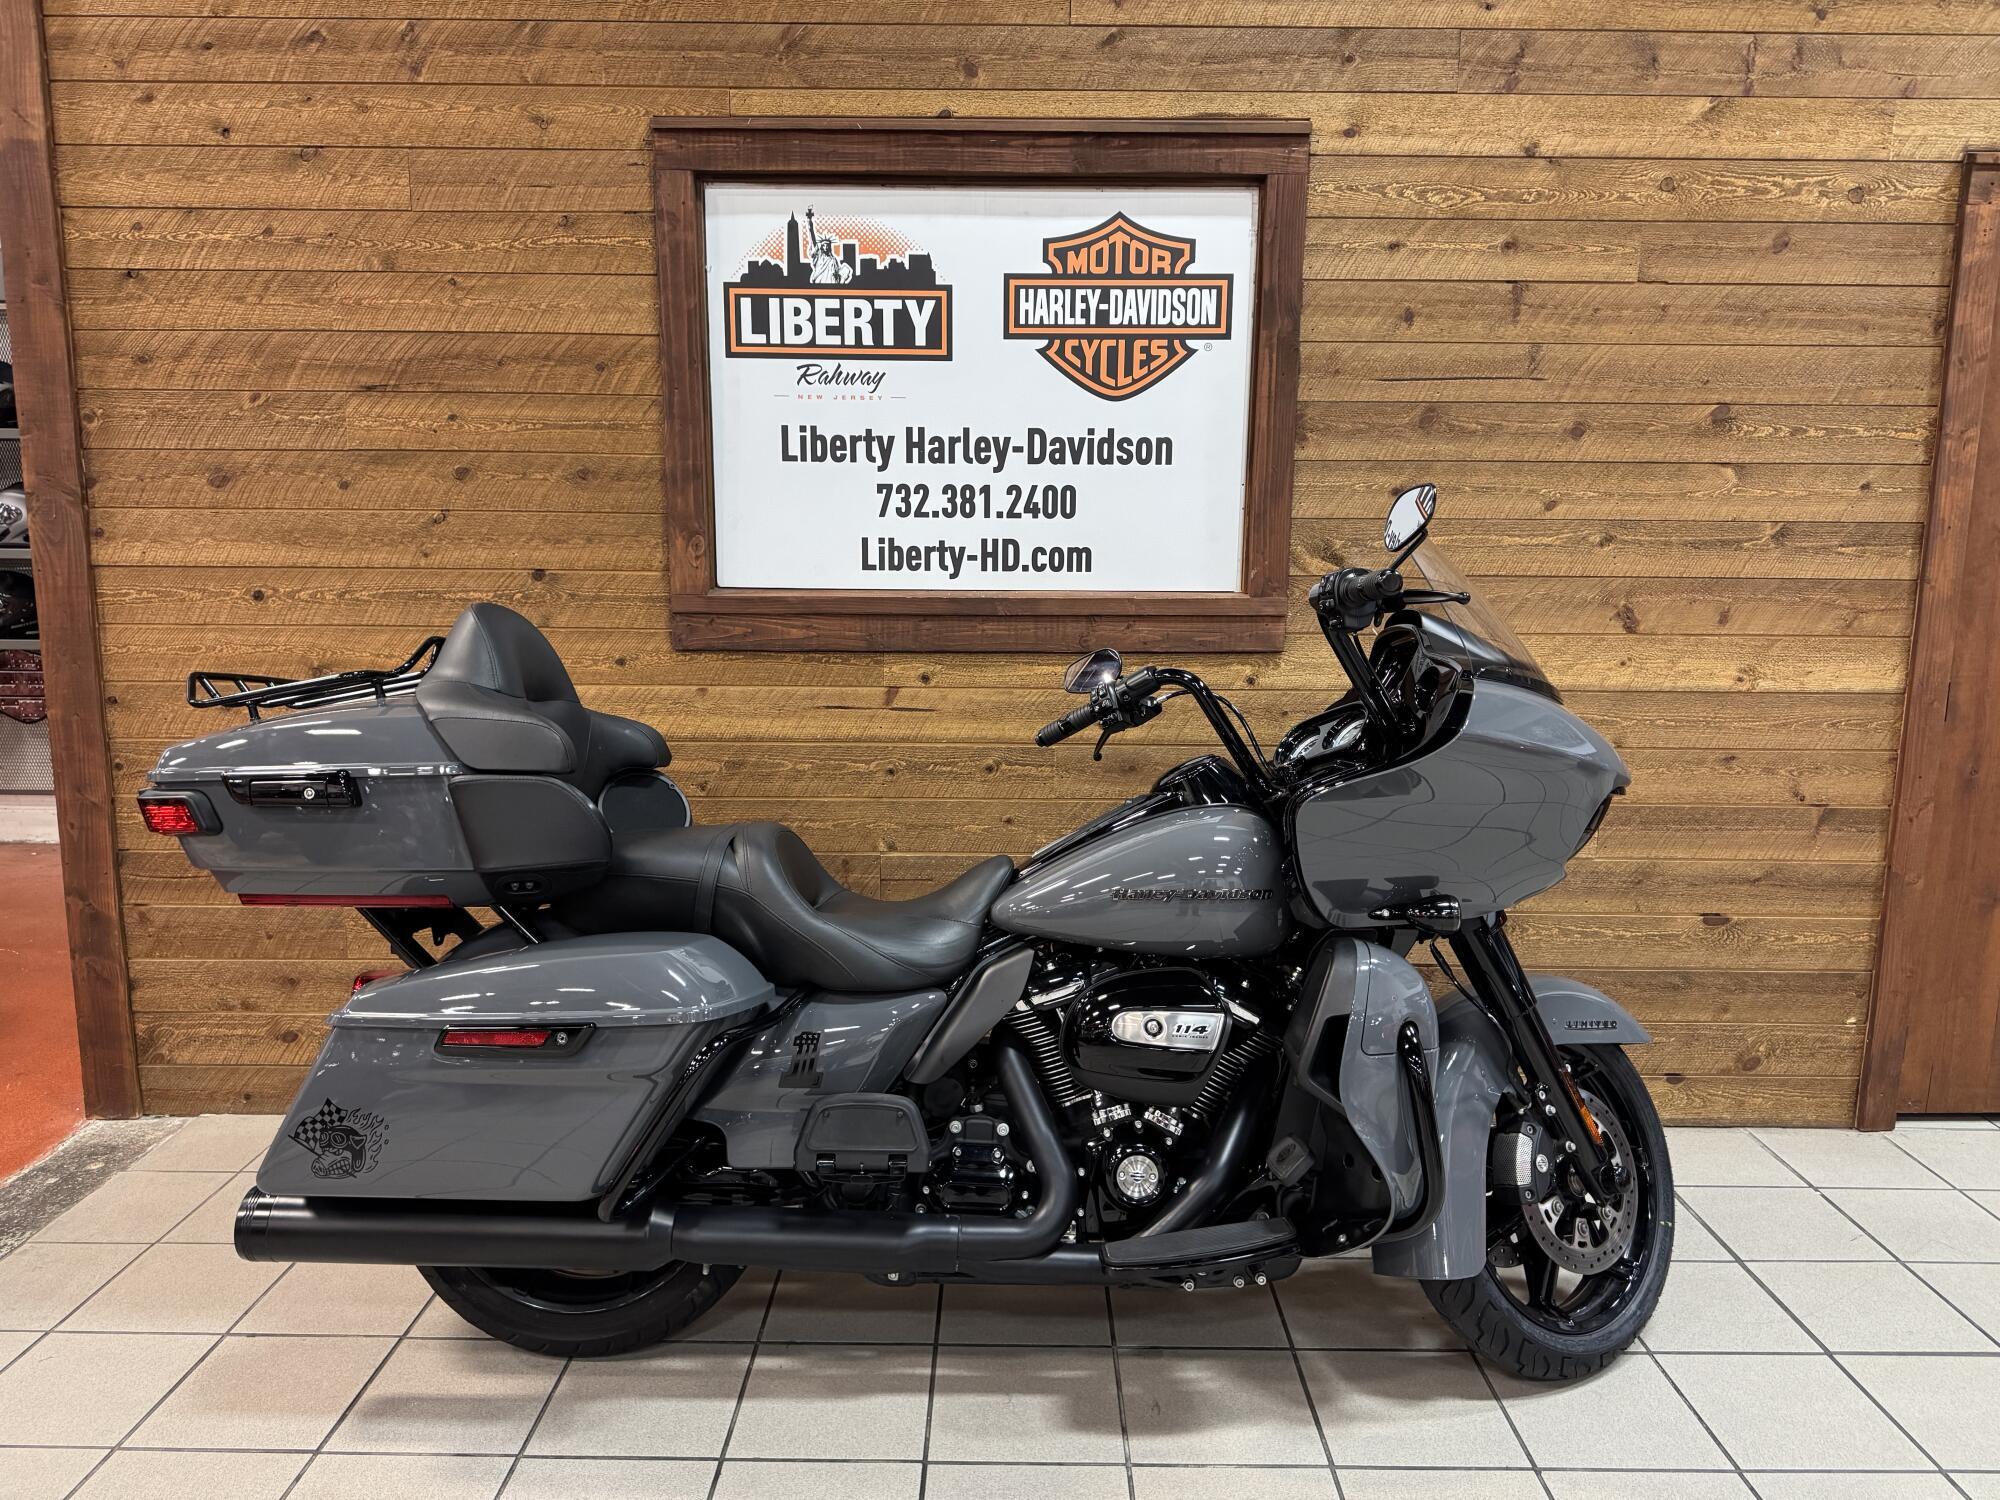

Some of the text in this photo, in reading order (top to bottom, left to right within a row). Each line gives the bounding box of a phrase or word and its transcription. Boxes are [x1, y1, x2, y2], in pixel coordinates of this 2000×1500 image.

[1066, 230, 1172, 275] MOTOR
[740, 297, 937, 347] LIBERTY
[1019, 287, 1218, 326] HARLEY-DAVIDSON
[796, 362, 886, 394] Rahway
[1064, 339, 1169, 387] CYCLES
[780, 424, 1173, 474] Liberty Harley-Davidson
[876, 483, 1077, 520] 732.381.2400
[861, 536, 1092, 580] Liberty-HD.com
[1173, 1024, 1210, 1034] 114
